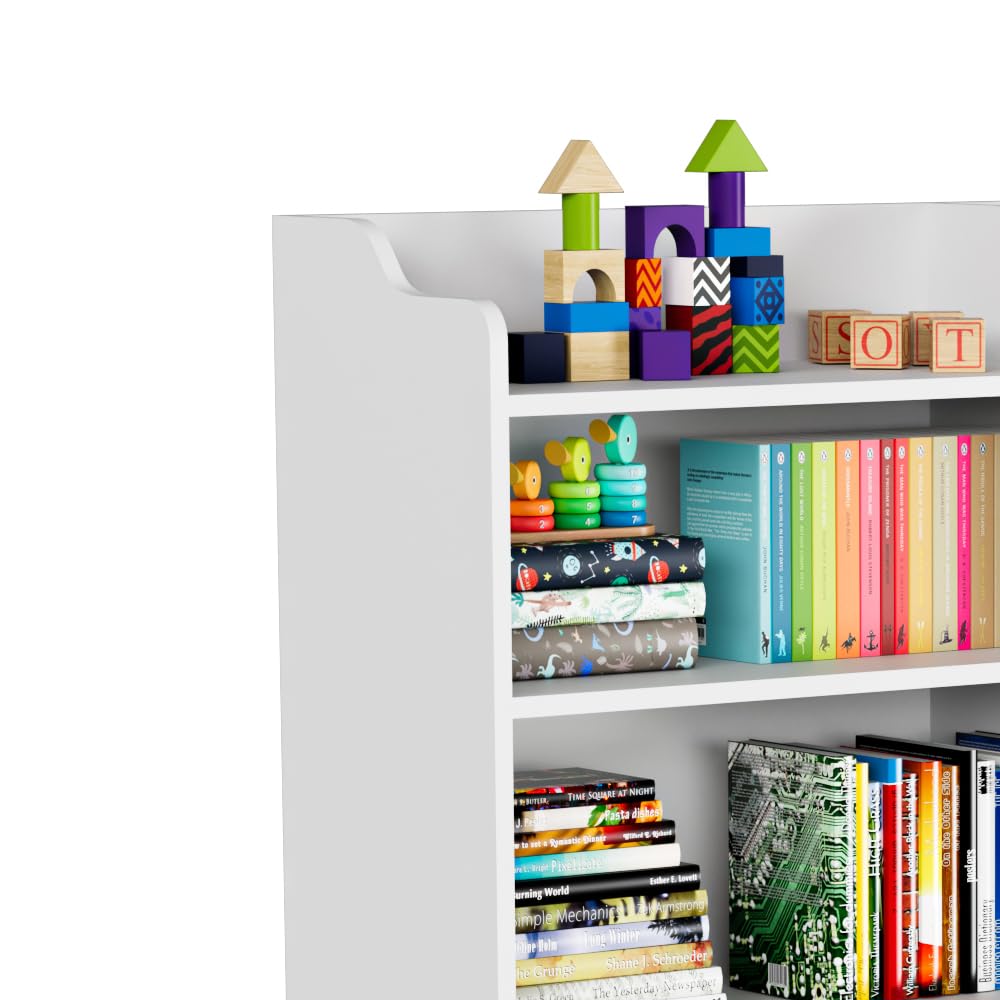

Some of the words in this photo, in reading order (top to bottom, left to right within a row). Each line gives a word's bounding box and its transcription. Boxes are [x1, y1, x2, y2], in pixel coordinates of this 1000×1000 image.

[861, 325, 893, 360] O
[945, 328, 974, 362] T
[942, 771, 951, 796] Side
[567, 791, 585, 802] TIME
[588, 790, 616, 800] SQUARE
[618, 788, 627, 798] AT
[629, 786, 655, 797] NIGHT
[604, 808, 630, 821] Pasta
[632, 806, 660, 820] dishes
[942, 798, 951, 830] Other
[521, 841, 528, 849] to
[582, 835, 607, 844] Dinner
[942, 832, 951, 850] the
[942, 852, 951, 867] On
[964, 849, 978, 883] posters
[650, 876, 670, 886] Esther
[671, 875, 677, 884] E.
[678, 873, 698, 883] Lovett
[544, 885, 570, 897] World
[556, 904, 622, 923] Mechanics
[655, 899, 705, 914] Armstrong
[978, 899, 994, 943] Dictionary
[609, 929, 641, 944] Winter
[606, 956, 639, 970] Shane
[653, 949, 708, 966] Schroeder
[978, 944, 992, 983] Business
[533, 964, 576, 978] Grunge
[905, 965, 915, 996] William
[593, 986, 611, 1000] The
[613, 981, 660, 998] Yesterday
[664, 976, 717, 993] Newspaper
